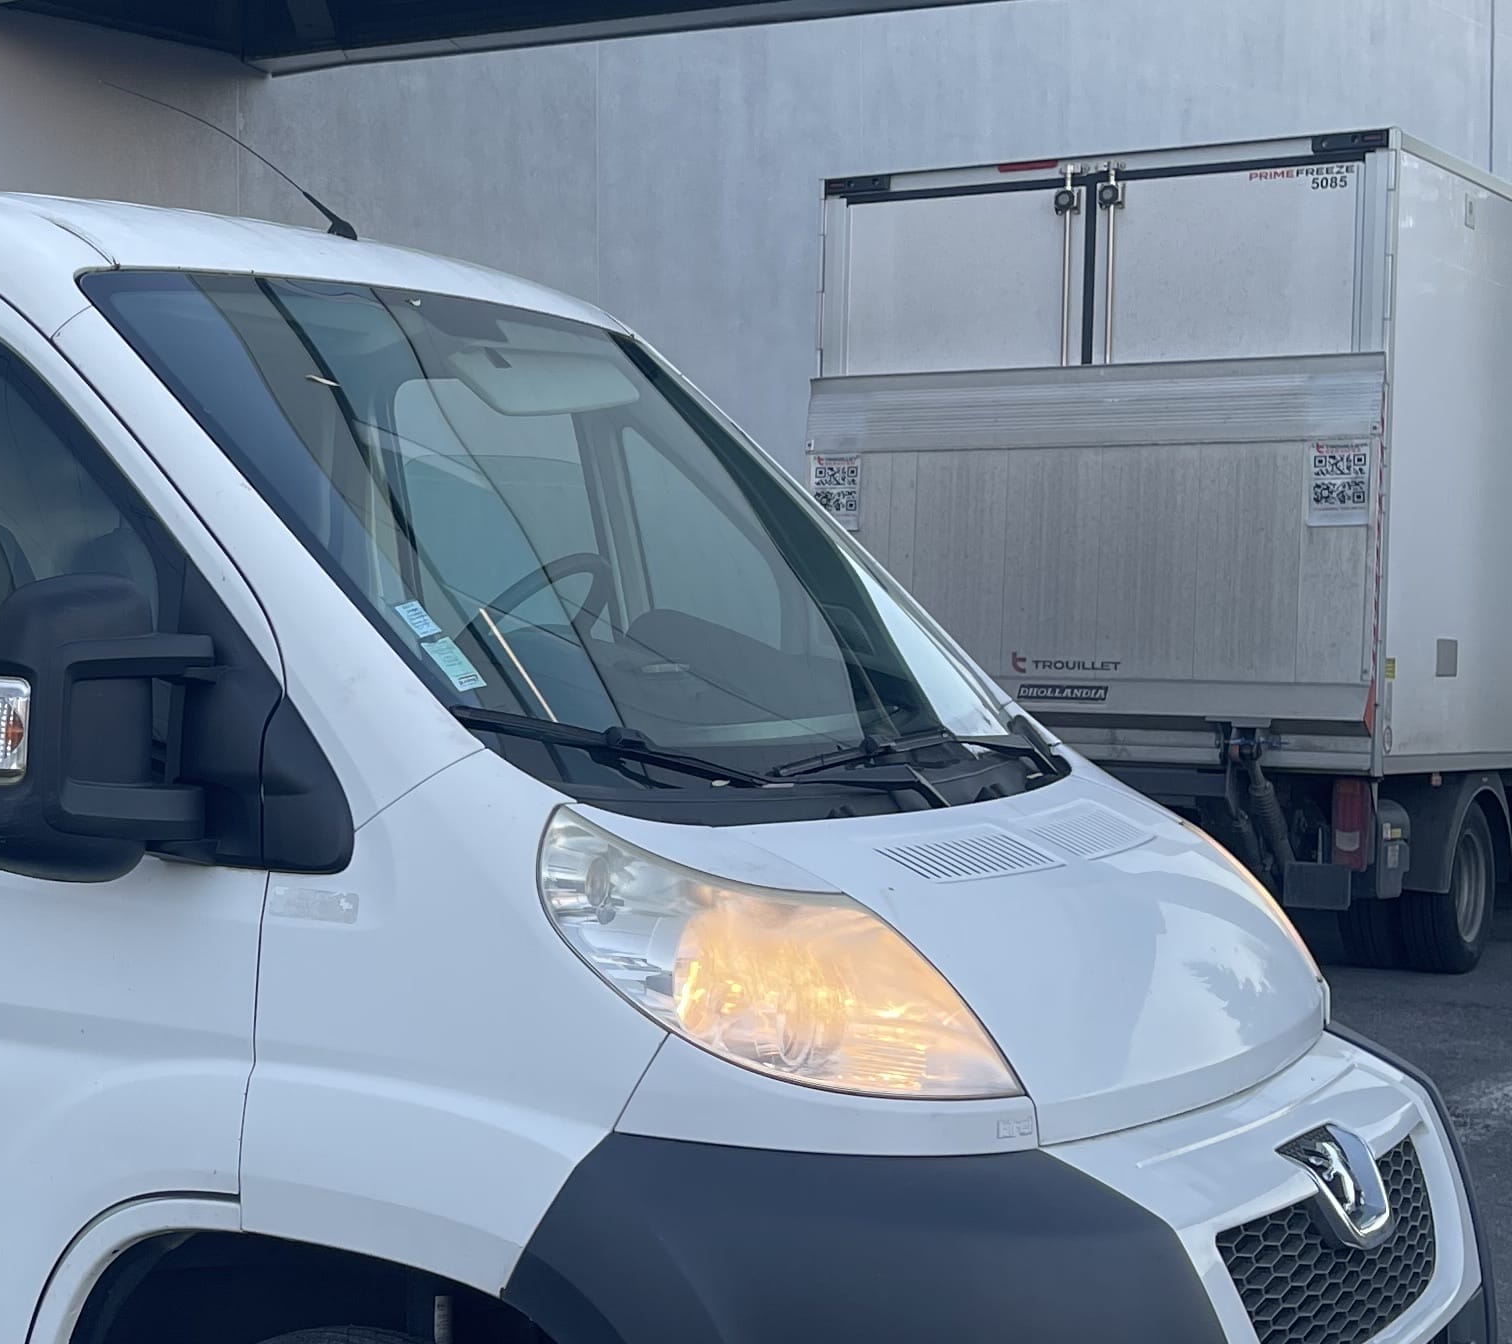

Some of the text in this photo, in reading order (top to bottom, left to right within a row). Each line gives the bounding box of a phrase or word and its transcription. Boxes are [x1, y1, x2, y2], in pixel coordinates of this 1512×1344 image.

[1311, 176, 1348, 190] 5085
[1031, 659, 1121, 671] TROUILLET
[1019, 686, 1106, 699] DHOLLANDIA
